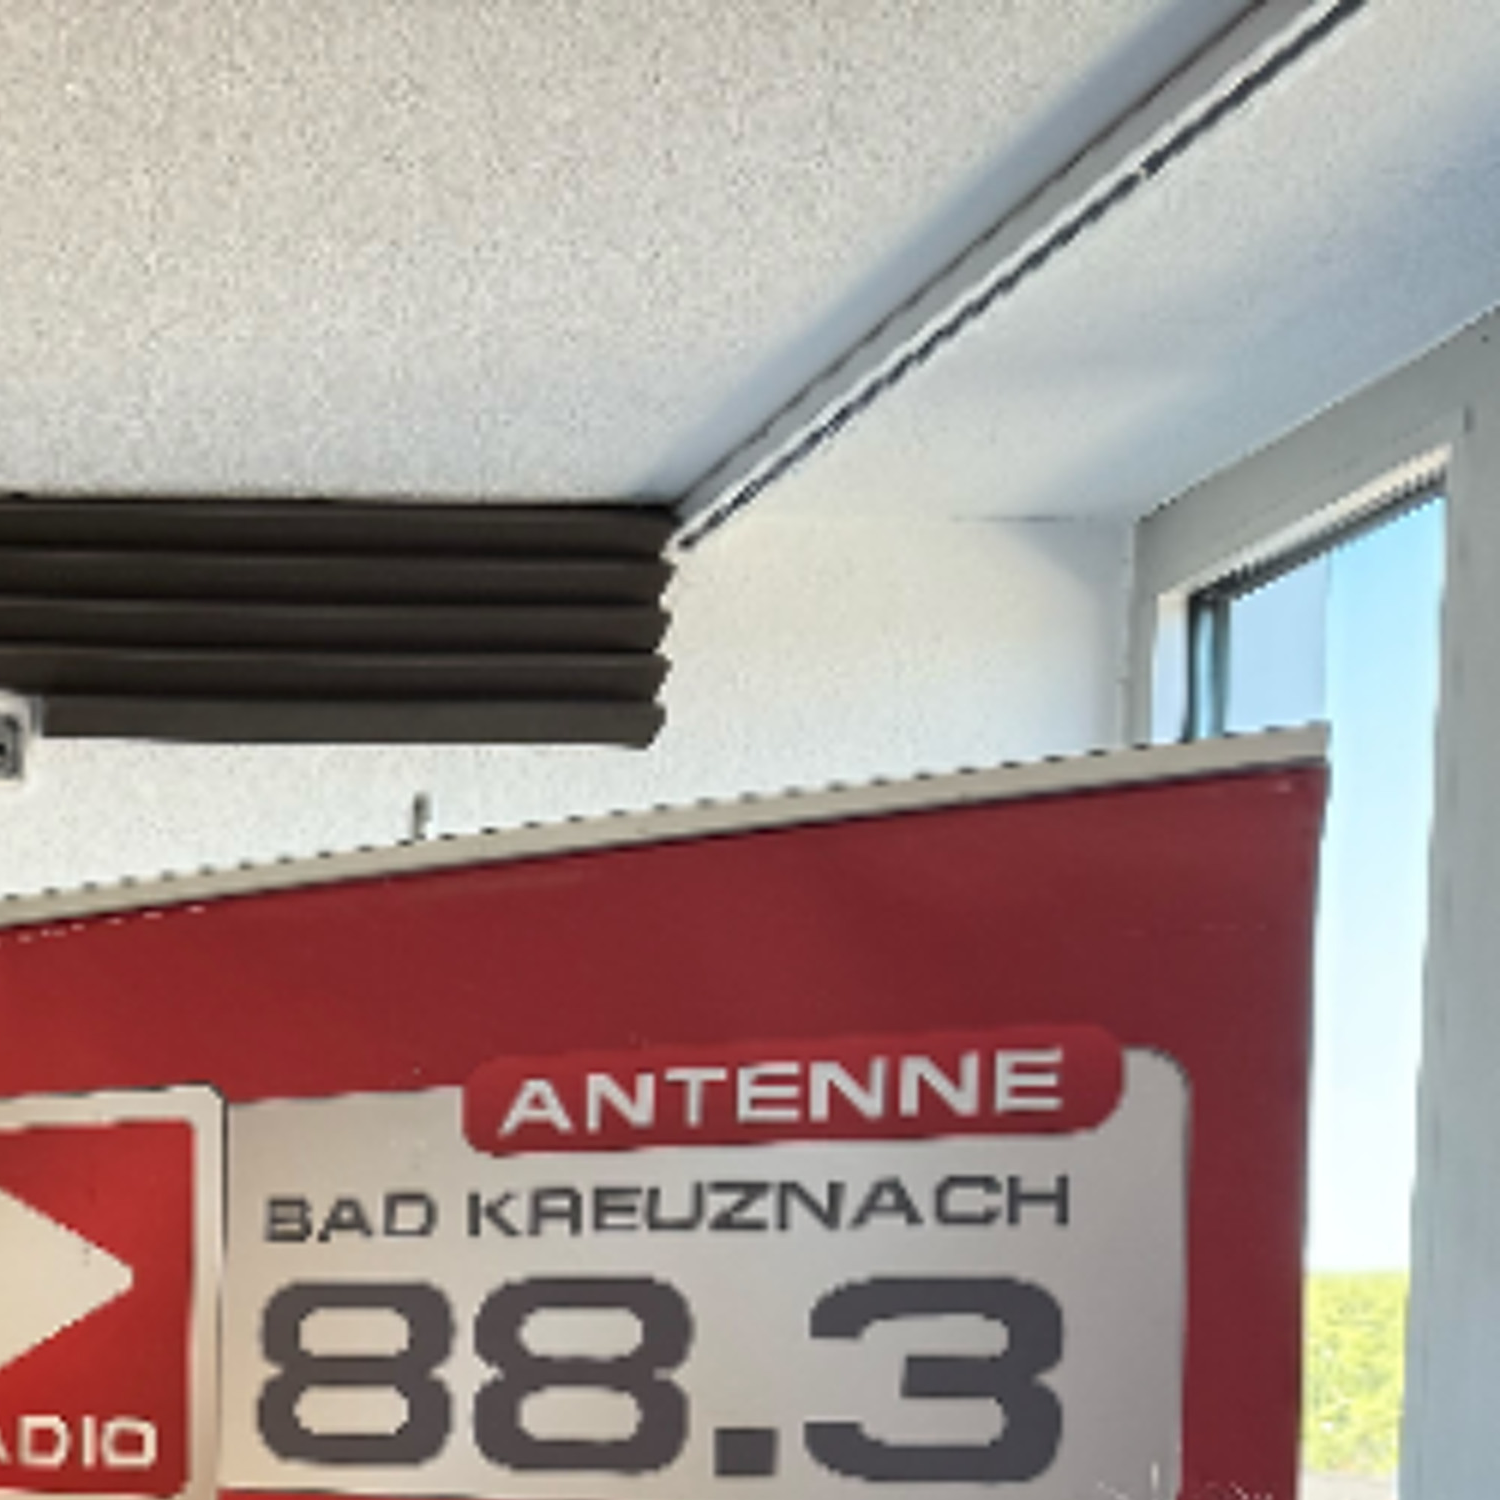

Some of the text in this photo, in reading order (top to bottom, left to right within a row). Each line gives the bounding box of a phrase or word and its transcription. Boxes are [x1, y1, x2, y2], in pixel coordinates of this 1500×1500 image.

[500, 1047, 1064, 1136] ANTENNE
[262, 1174, 1071, 1244] BAD KREUZNACH
[255, 1275, 1066, 1484] 88.3
